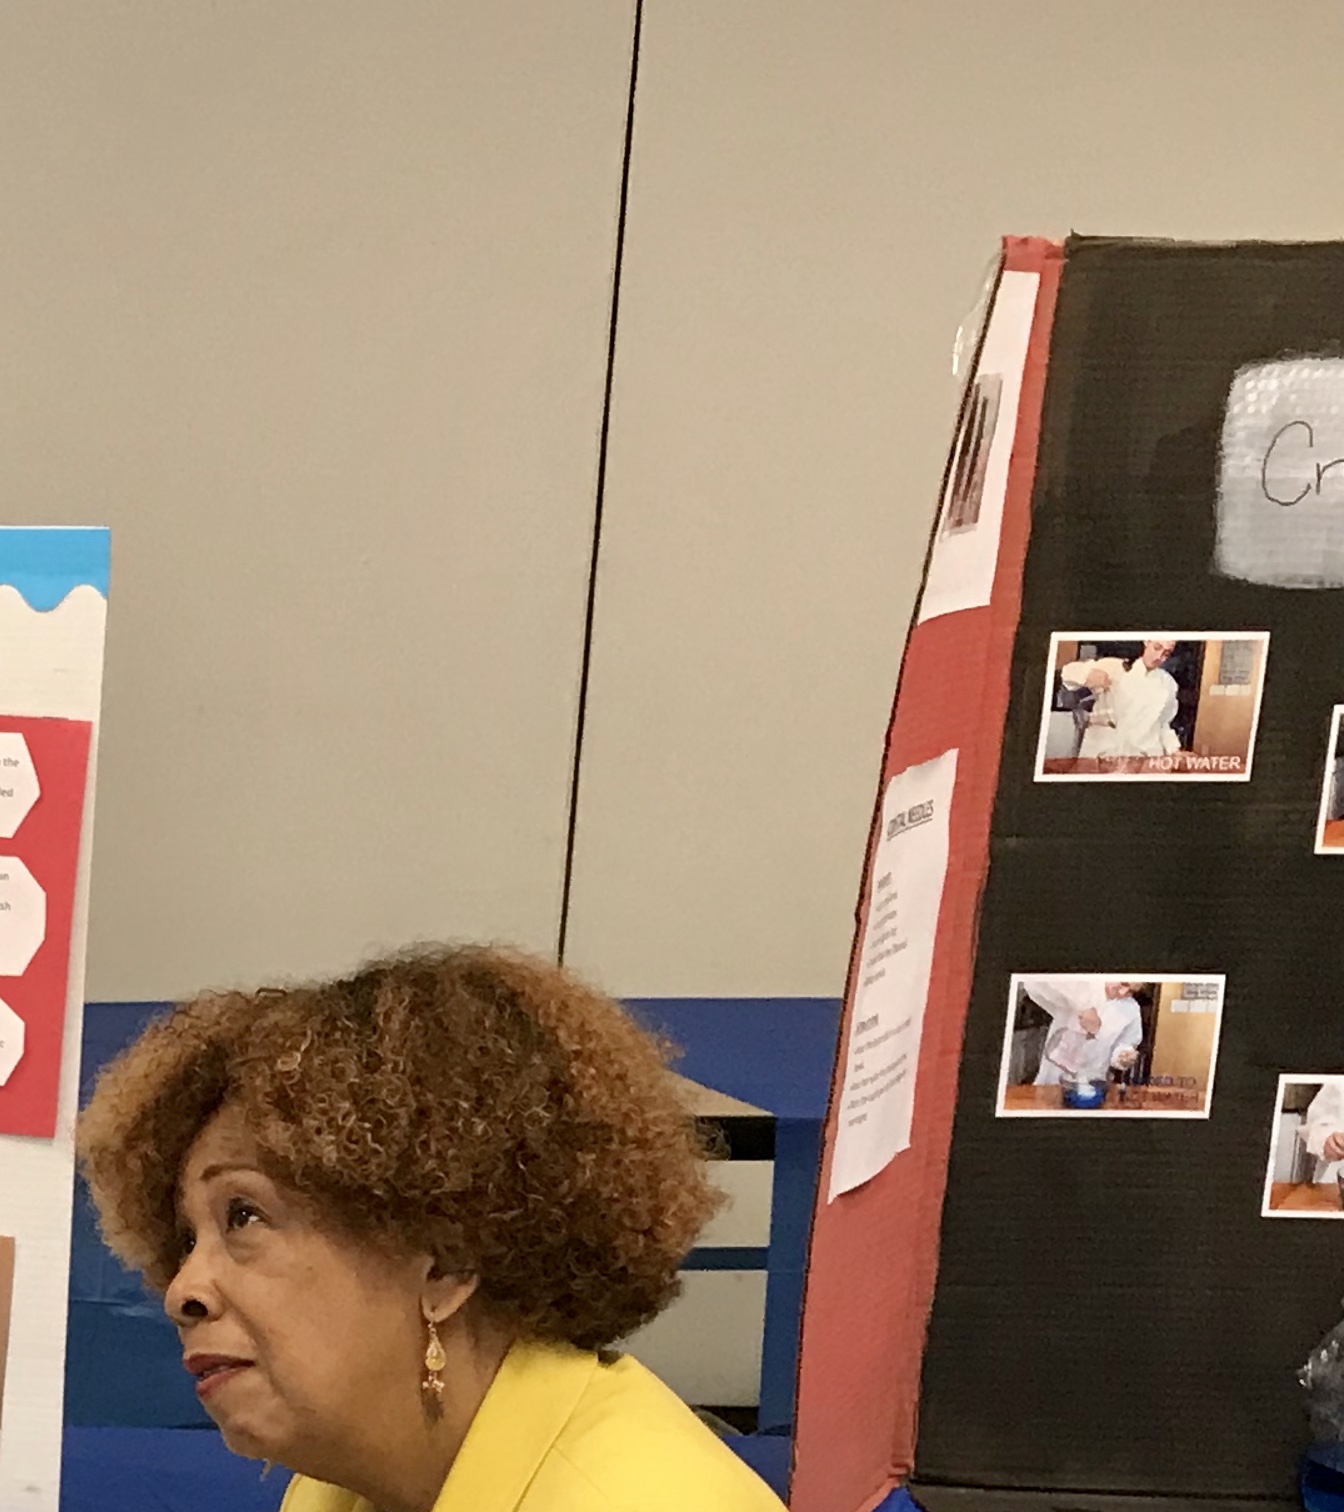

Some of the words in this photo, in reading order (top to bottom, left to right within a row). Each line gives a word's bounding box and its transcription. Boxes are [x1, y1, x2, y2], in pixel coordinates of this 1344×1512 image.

[3, 757, 19, 767] the
[1149, 757, 1180, 770] HOT
[1186, 756, 1240, 770] WATER
